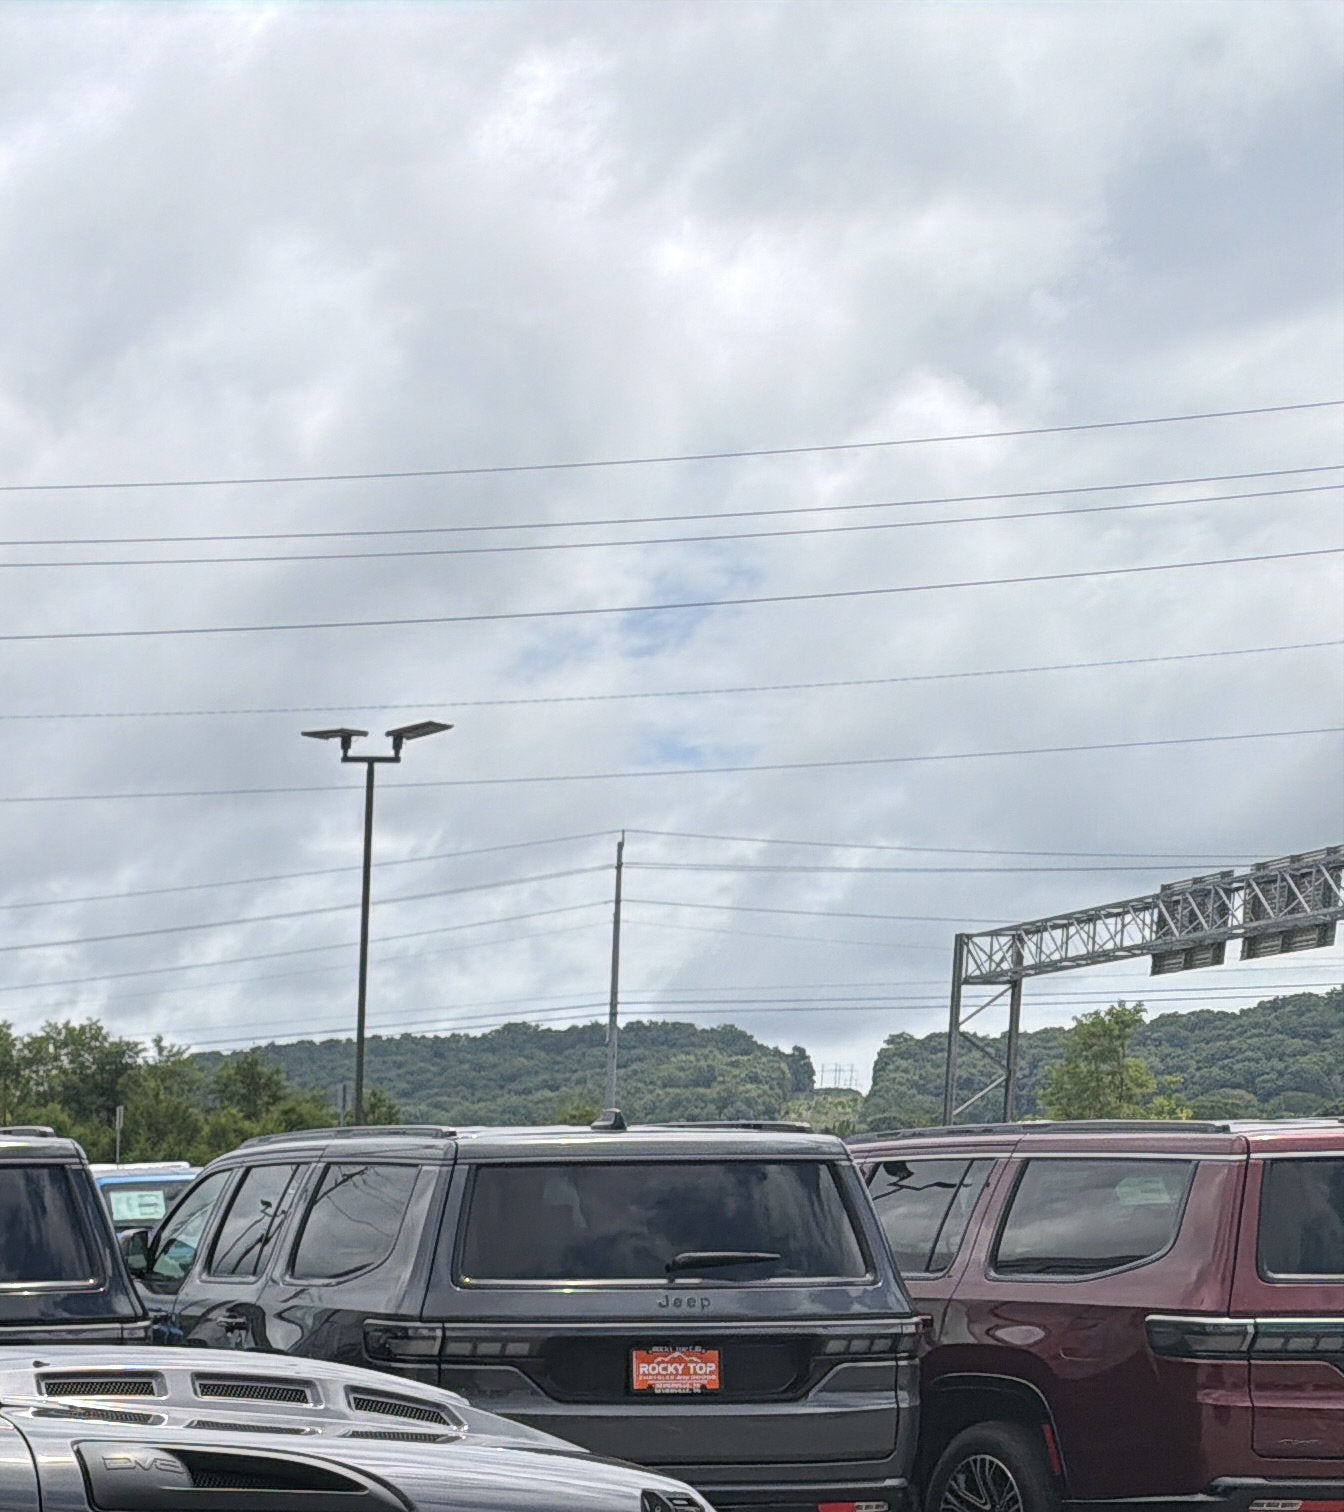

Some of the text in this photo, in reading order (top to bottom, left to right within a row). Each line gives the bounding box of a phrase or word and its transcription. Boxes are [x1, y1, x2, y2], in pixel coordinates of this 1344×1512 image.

[657, 1294, 711, 1311] Jeep
[639, 1363, 717, 1375] ROCKY TOP
